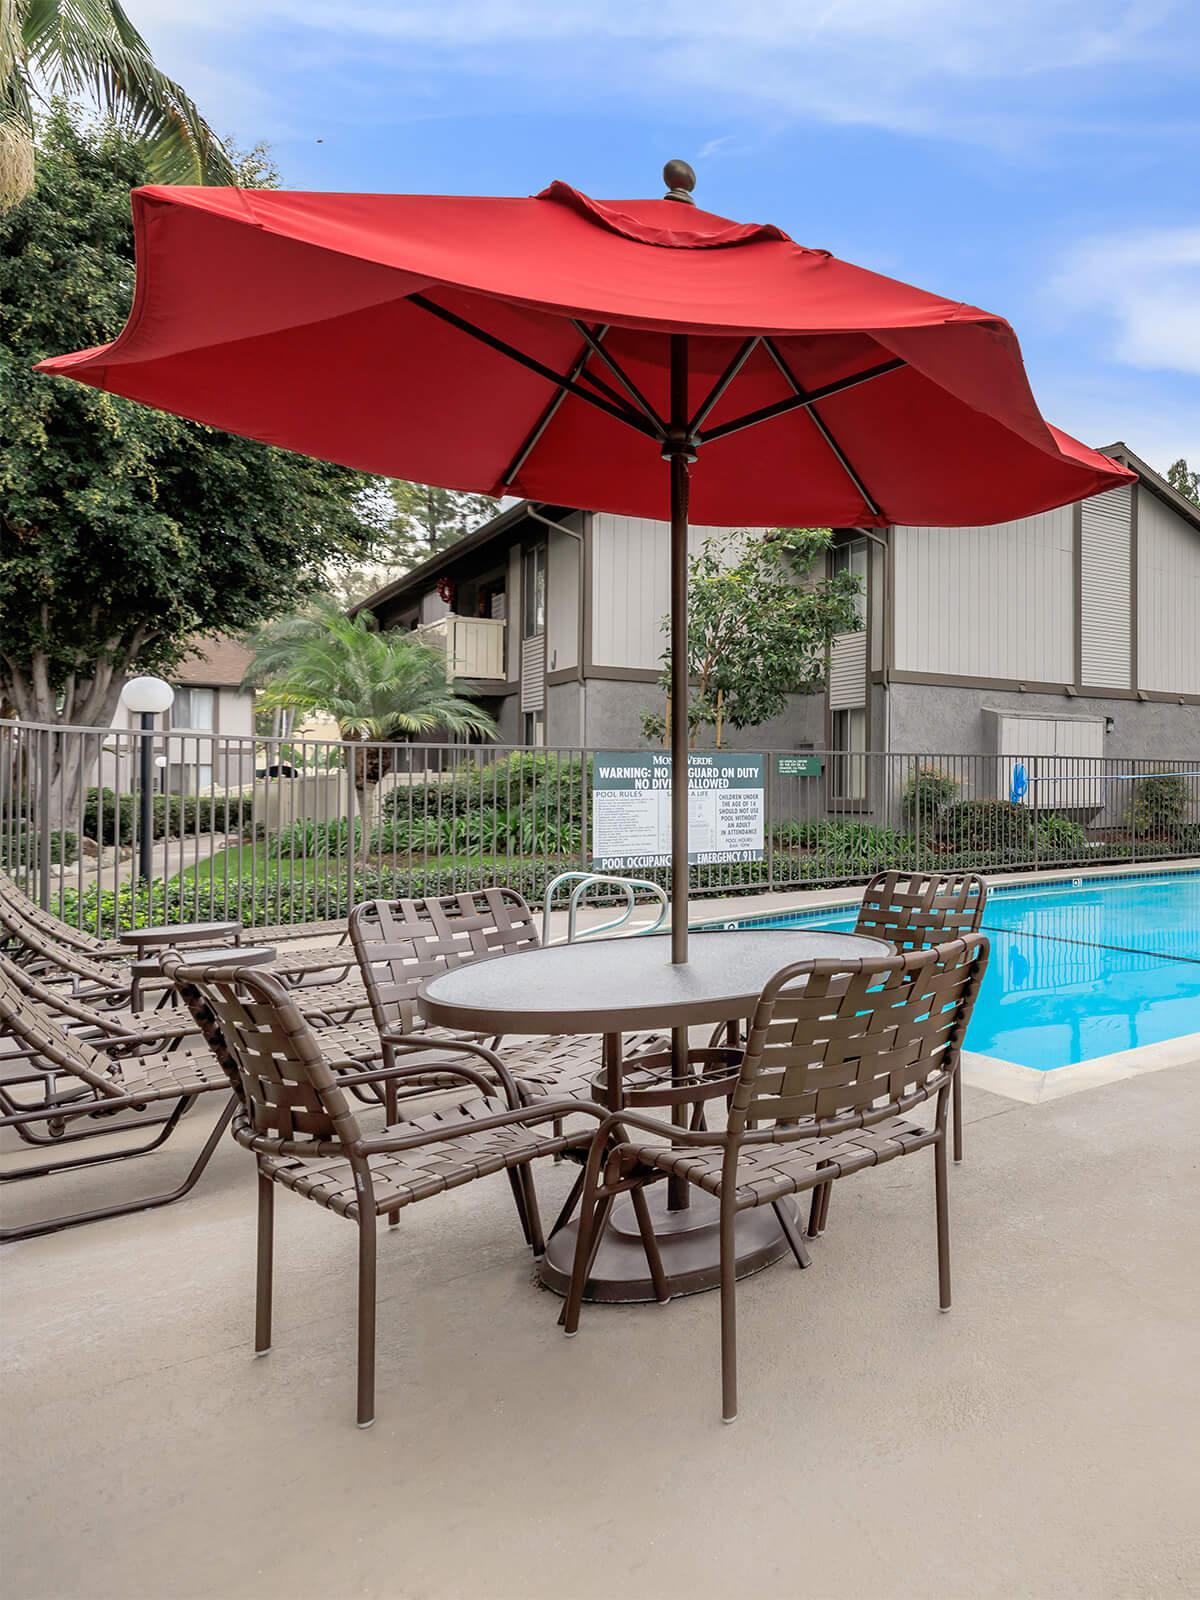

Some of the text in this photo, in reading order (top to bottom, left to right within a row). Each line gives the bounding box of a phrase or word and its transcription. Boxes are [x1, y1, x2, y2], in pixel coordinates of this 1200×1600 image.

[599, 767, 759, 778] WARNING: NO GUARD ON DUTY
[634, 778, 729, 789] NO DIVI ALLOWED
[602, 855, 672, 869] POOL OCCUPANC
[697, 850, 756, 864] EMERGENCY 911
